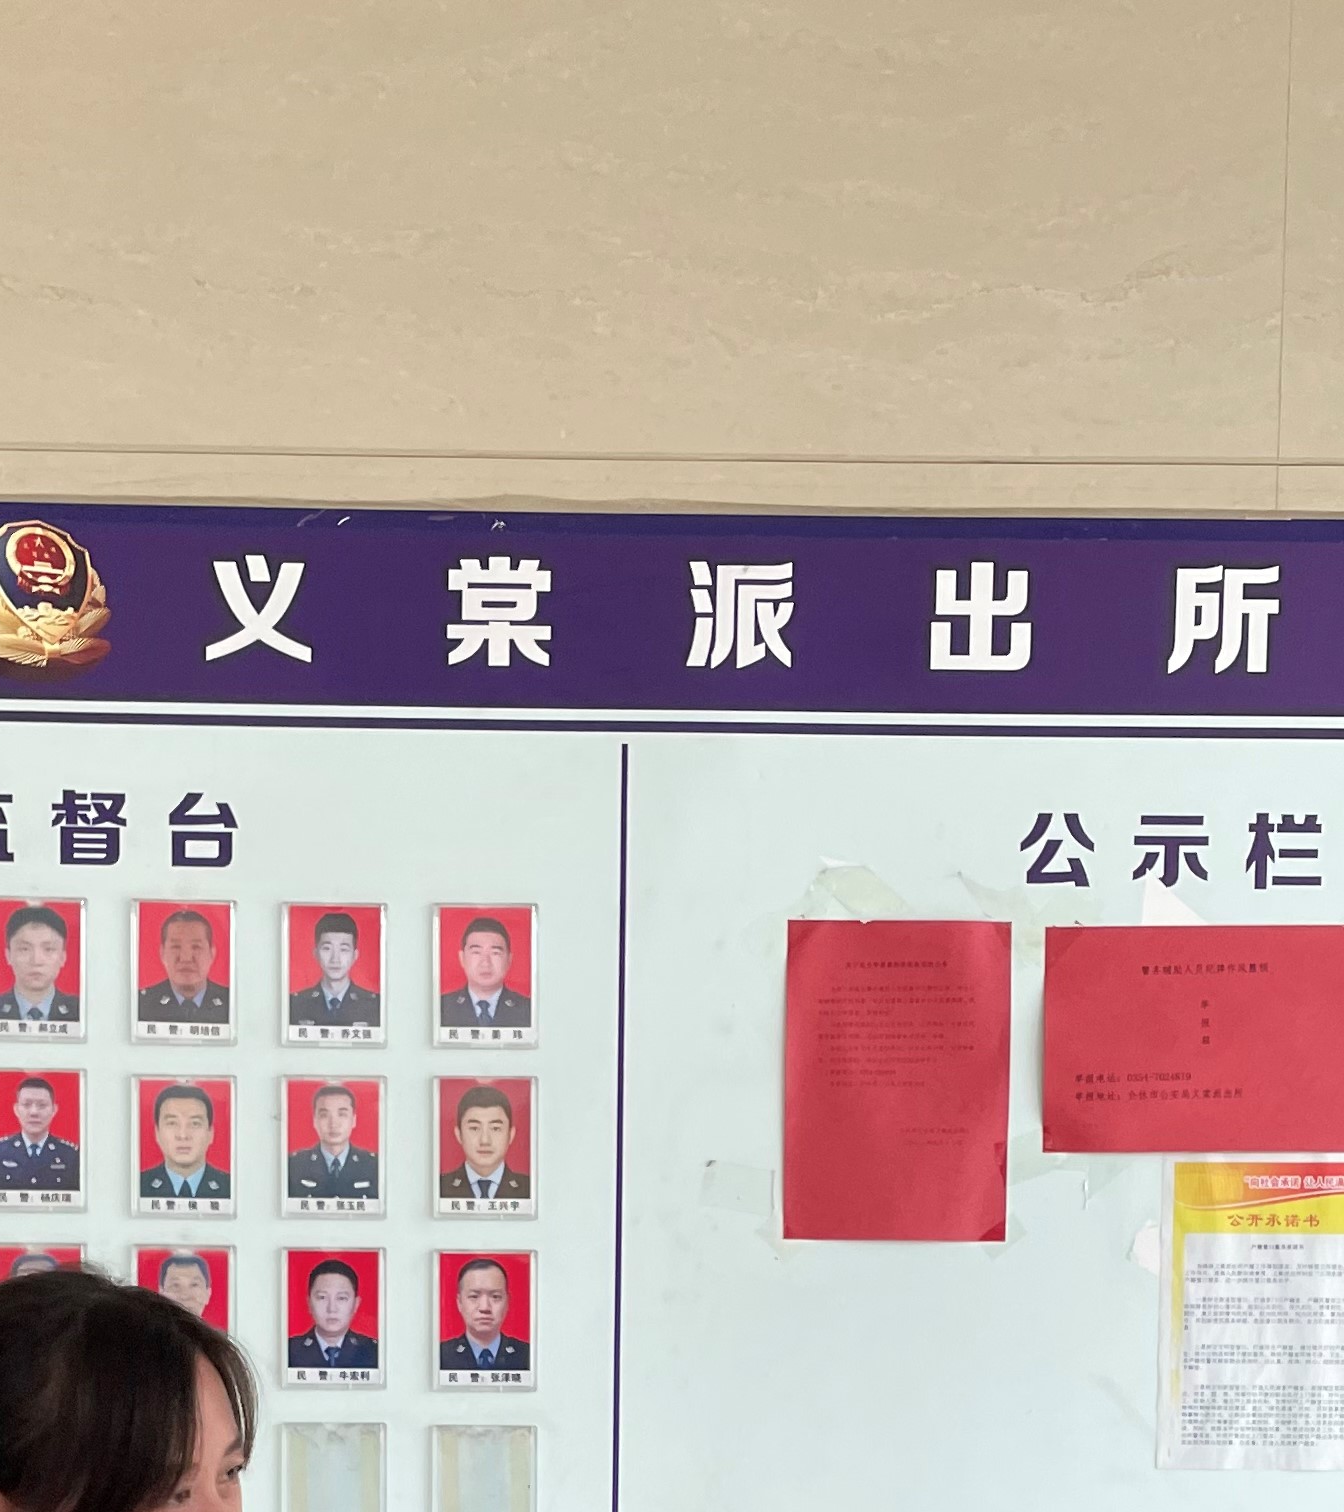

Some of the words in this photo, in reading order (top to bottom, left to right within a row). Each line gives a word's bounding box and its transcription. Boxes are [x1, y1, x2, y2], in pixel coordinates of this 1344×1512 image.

[204, 553, 1282, 675] 义棠派出所
[1019, 812, 1325, 891] 公示栏
[1227, 1213, 1320, 1228] 公开承诺书
